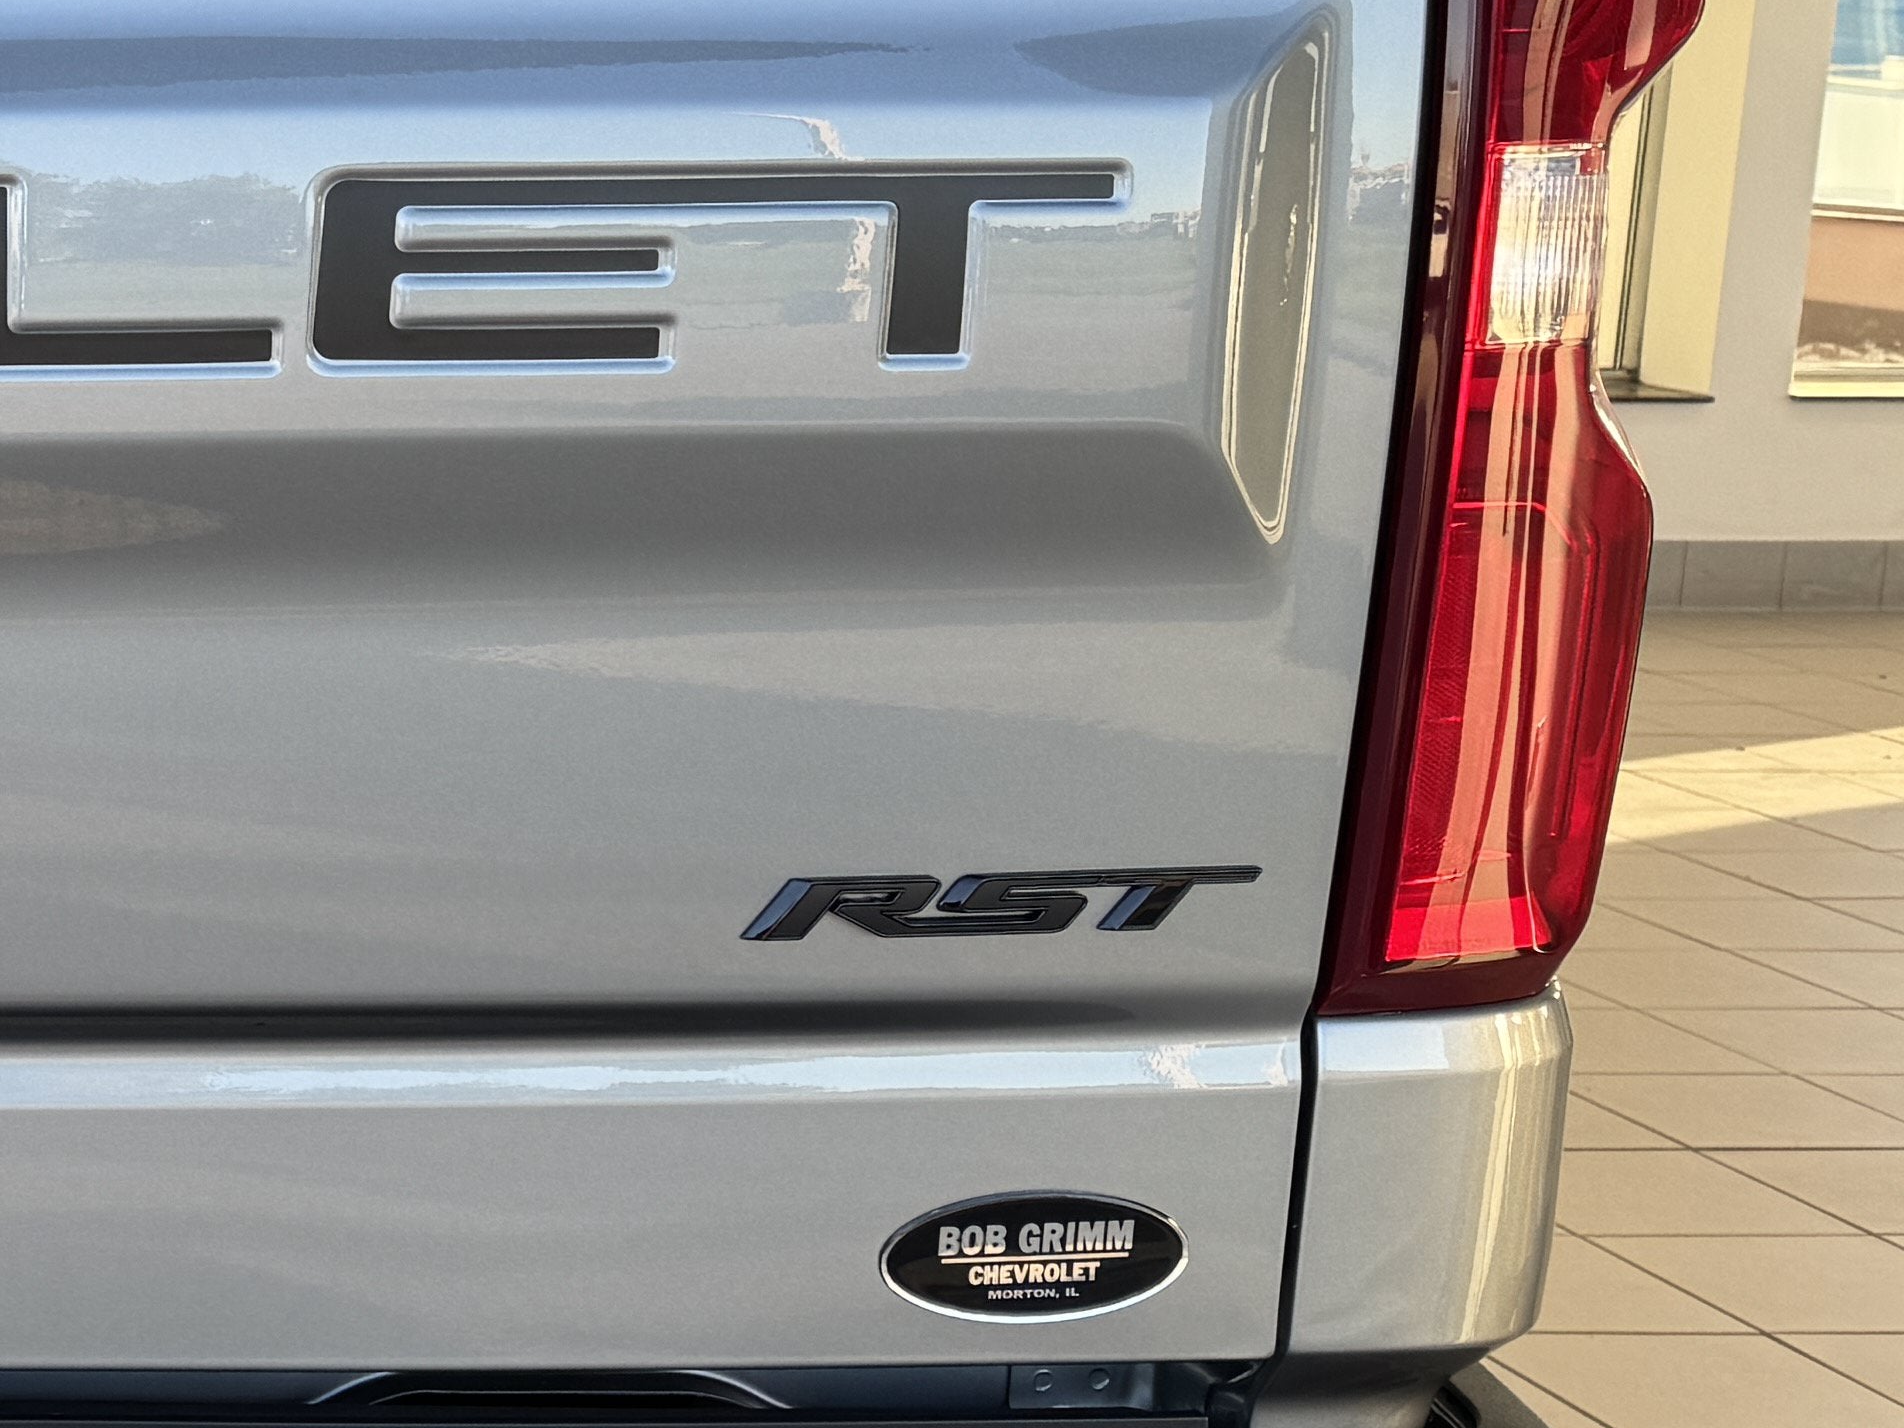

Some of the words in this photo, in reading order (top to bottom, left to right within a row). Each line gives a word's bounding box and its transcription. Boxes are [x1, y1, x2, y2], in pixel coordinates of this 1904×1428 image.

[740, 864, 1263, 941] RST
[937, 1225, 1007, 1257] BOB
[1019, 1220, 1135, 1254] GRIMM
[968, 1261, 1100, 1286] CHEVROLET
[988, 1288, 1060, 1301] MORTON,
[1065, 1288, 1080, 1297] IL
